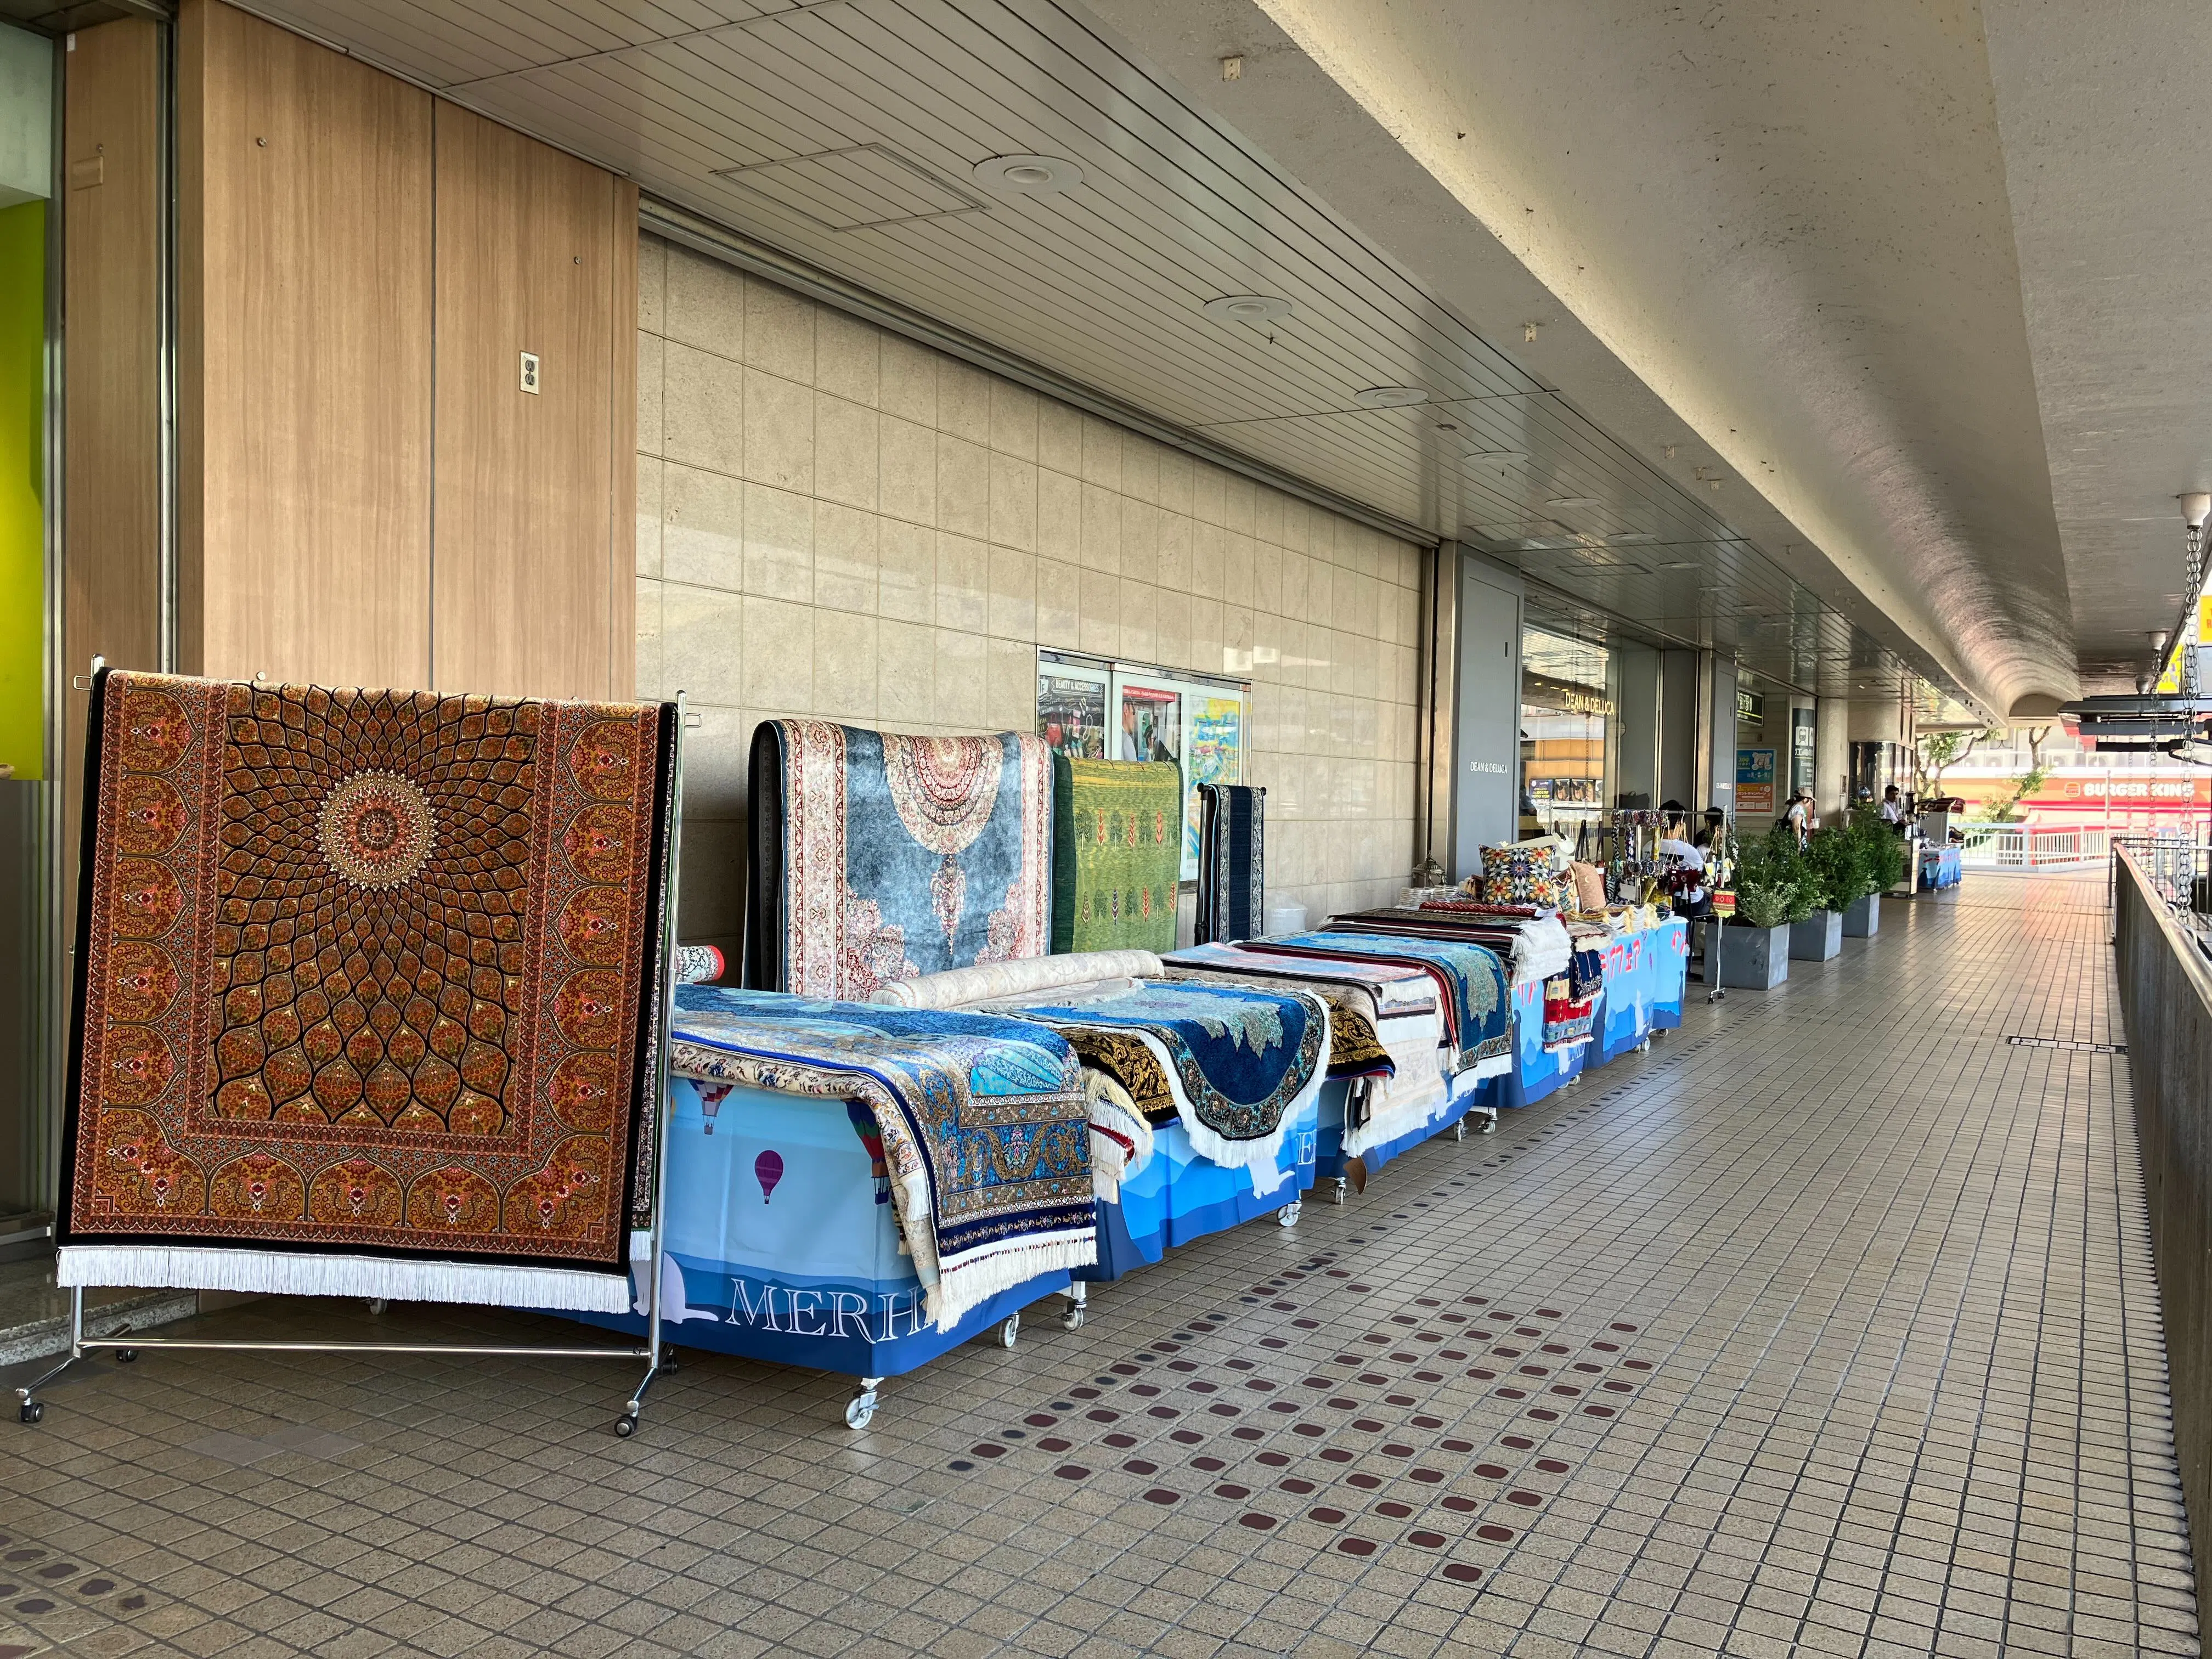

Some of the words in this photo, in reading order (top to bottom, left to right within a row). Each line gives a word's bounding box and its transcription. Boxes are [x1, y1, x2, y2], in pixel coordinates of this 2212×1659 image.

[1056, 679, 1070, 690] BEAUTY
[1074, 681, 1099, 693] ACCESSORIES
[1565, 692, 1584, 710] DEAN
[1584, 696, 1590, 712] &
[1590, 697, 1615, 716] DELUCA
[1470, 761, 1485, 772] DEAN
[1485, 763, 1488, 772] &
[1489, 763, 1508, 774] DELUCA
[2084, 783, 2148, 797] BURGER
[2151, 783, 2194, 797] KING
[725, 1278, 935, 1344] MERH
